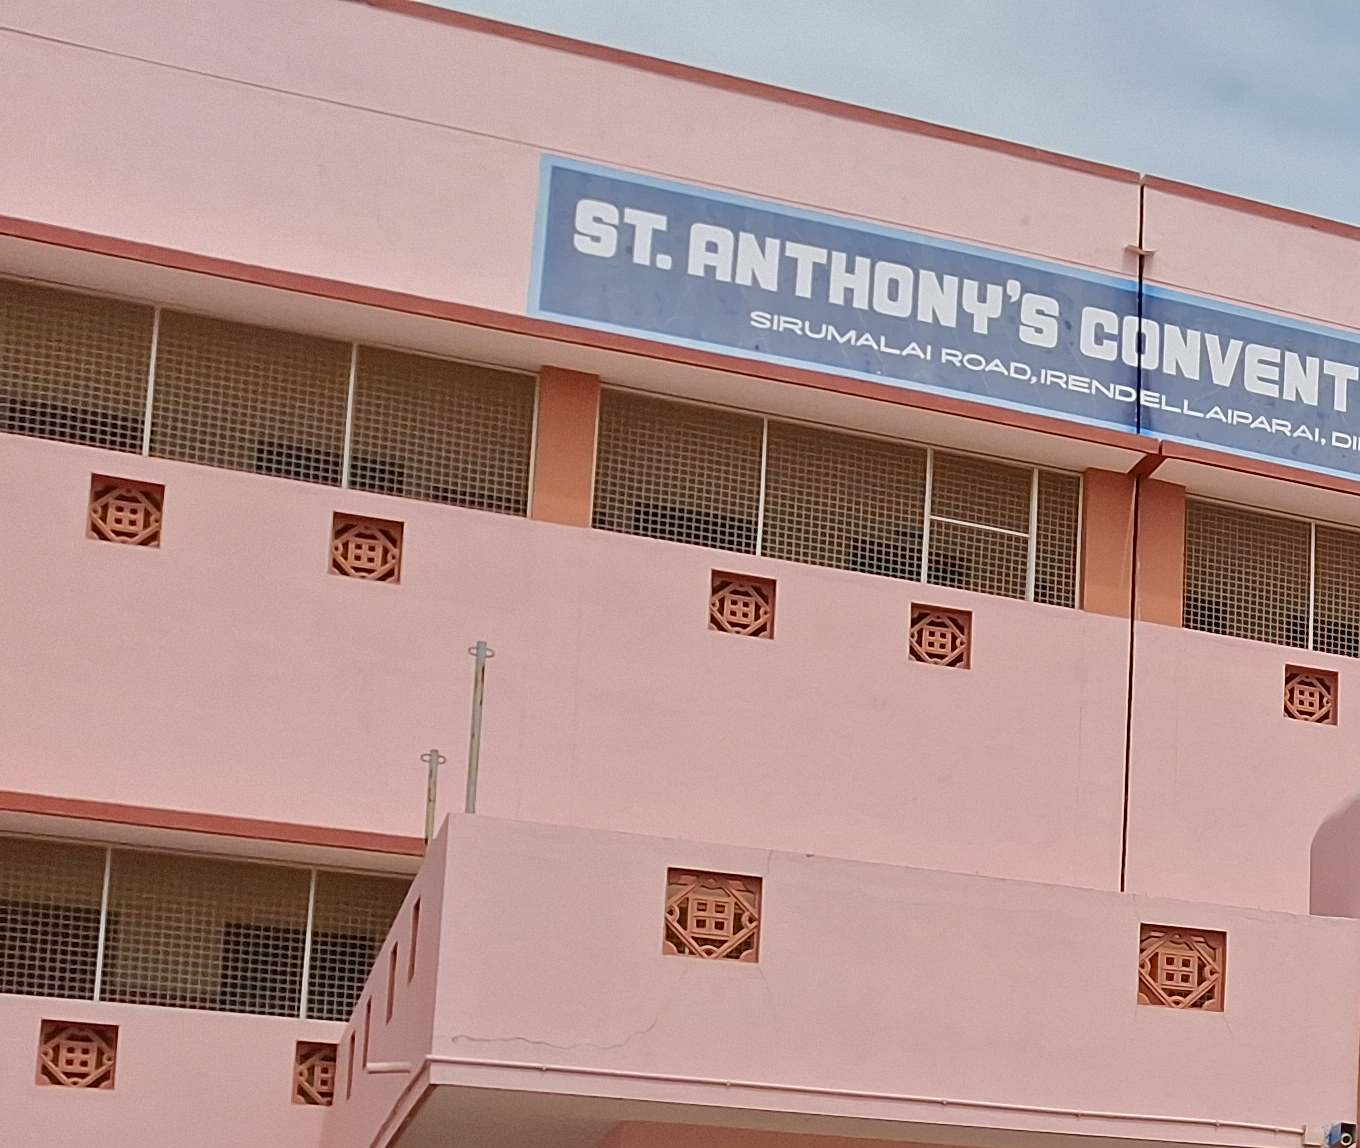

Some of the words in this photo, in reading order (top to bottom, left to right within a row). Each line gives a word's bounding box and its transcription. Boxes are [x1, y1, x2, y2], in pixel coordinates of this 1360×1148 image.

[573, 198, 673, 271] ST.
[687, 221, 1059, 349] ANTHONY'S
[1079, 305, 1360, 413] CONVENT
[749, 310, 932, 361] SIRUMALAI
